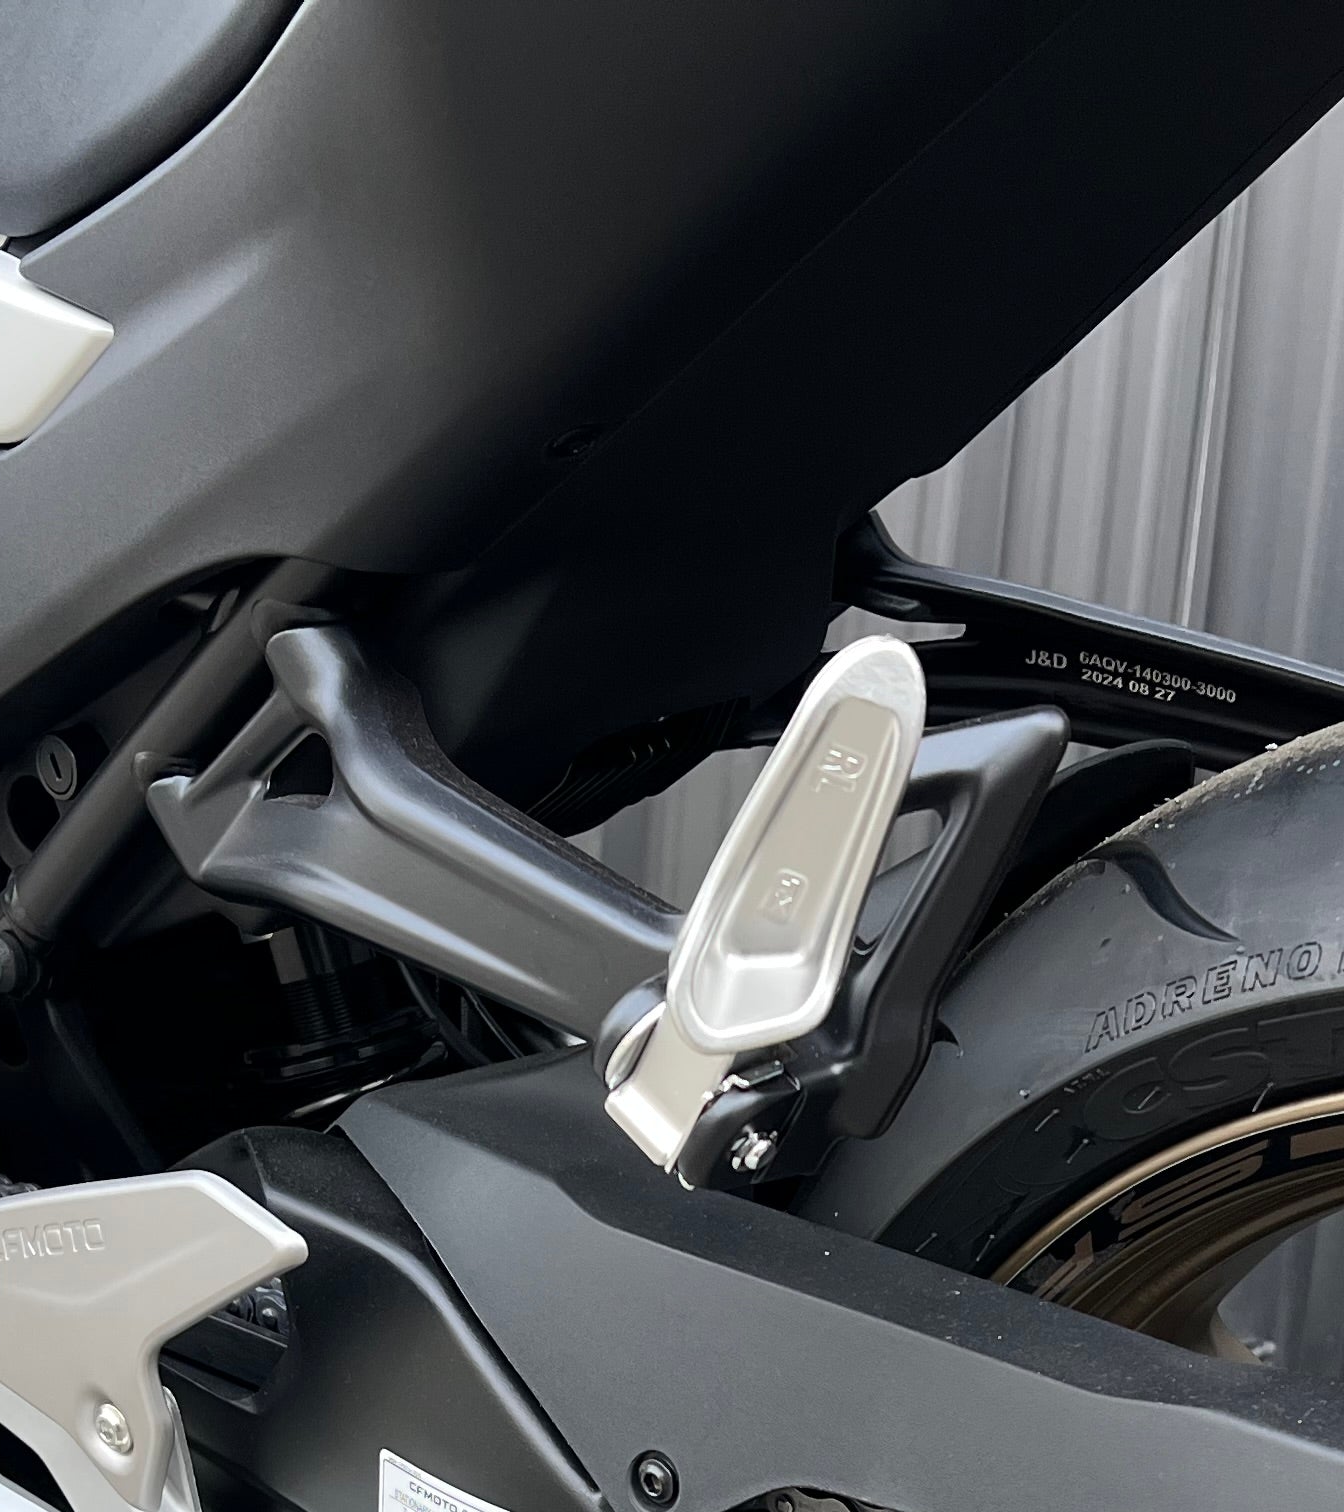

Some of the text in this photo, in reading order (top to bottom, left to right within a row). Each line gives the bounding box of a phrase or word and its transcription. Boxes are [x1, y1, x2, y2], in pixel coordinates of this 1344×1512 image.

[1025, 649, 1236, 704] J&D 6AQV-140300-3000
[1081, 668, 1176, 702] 2024 08 27
[1084, 940, 1322, 1053] ADRENO
